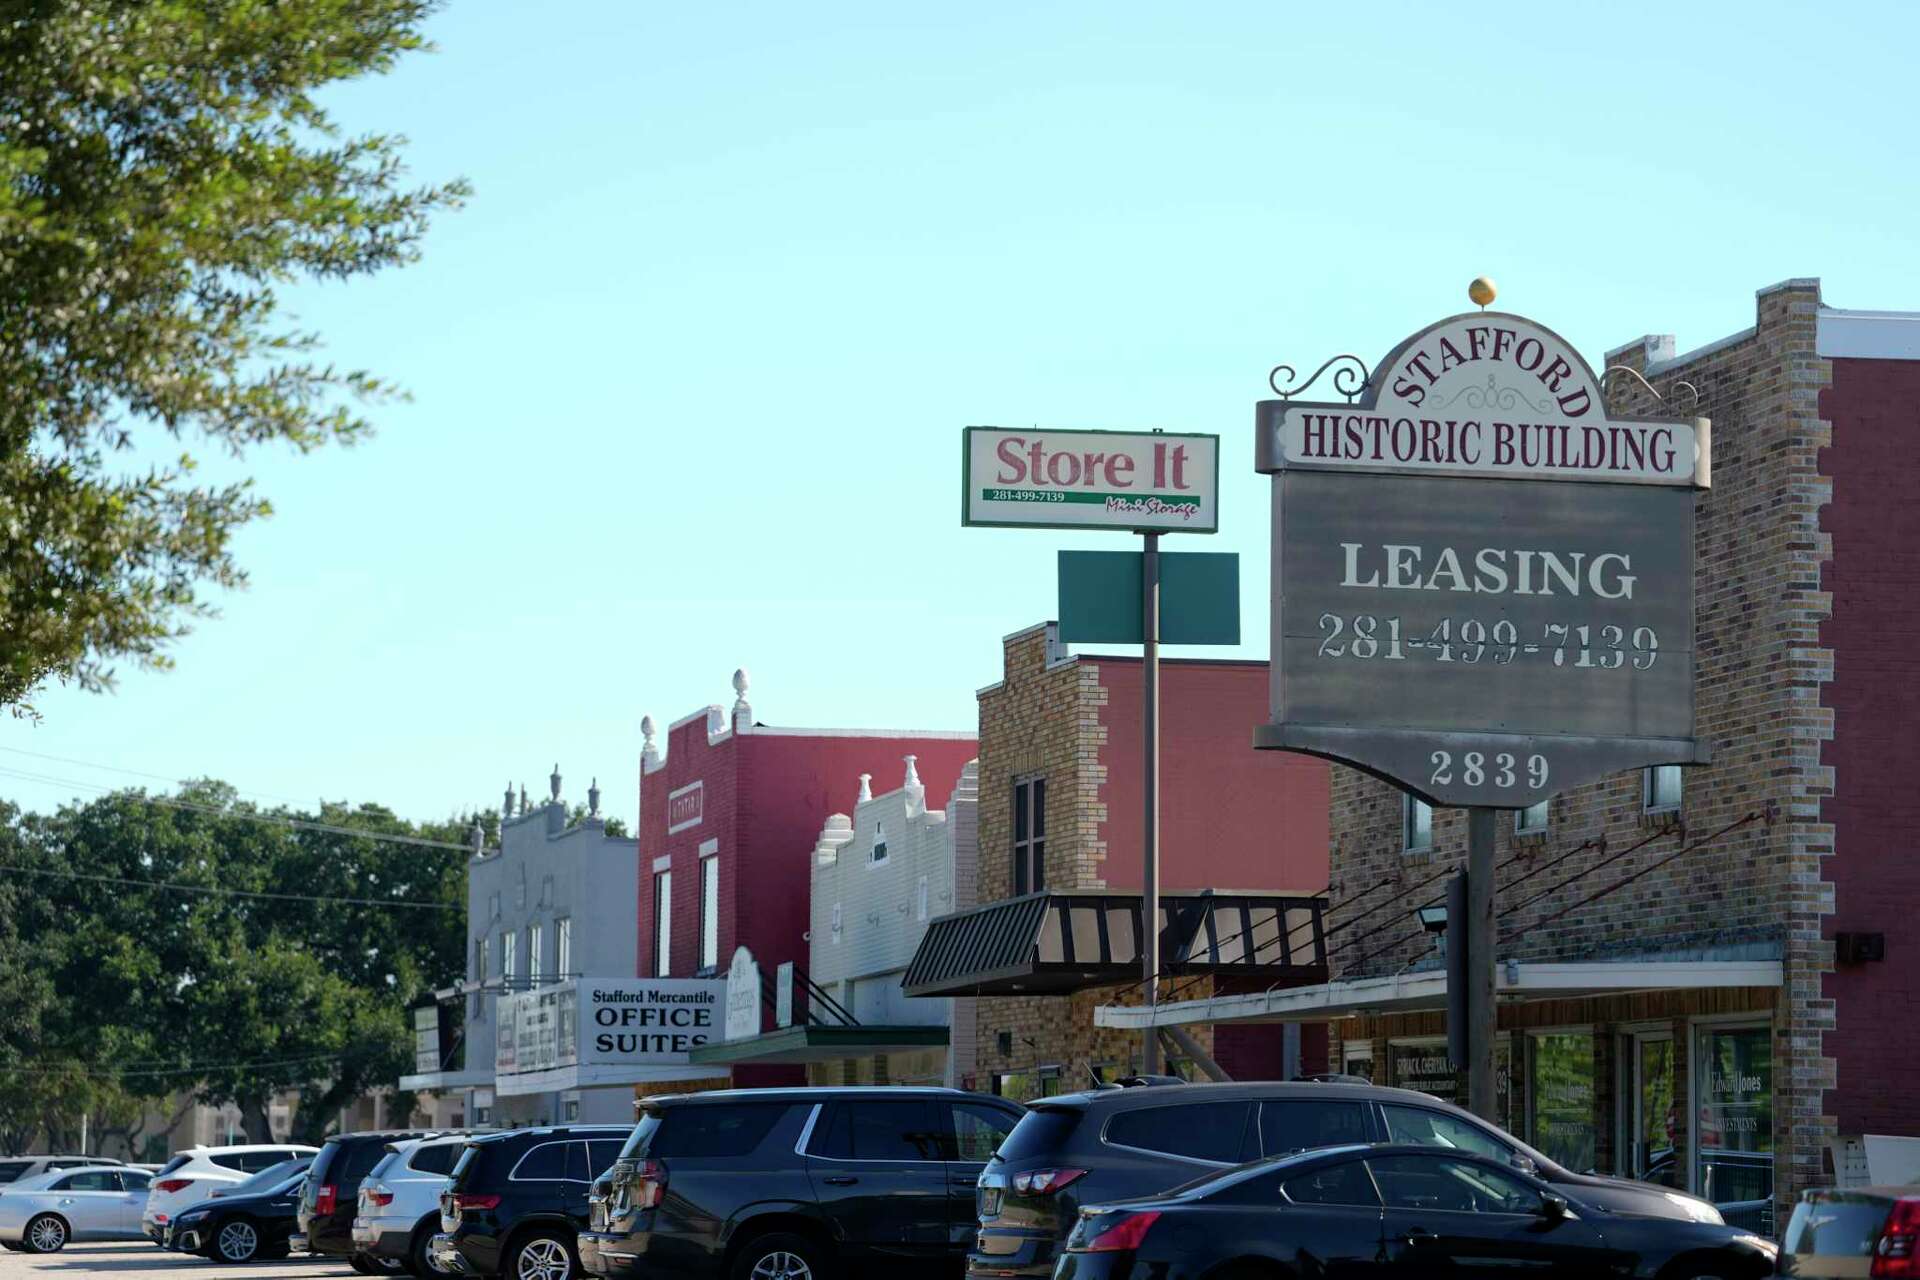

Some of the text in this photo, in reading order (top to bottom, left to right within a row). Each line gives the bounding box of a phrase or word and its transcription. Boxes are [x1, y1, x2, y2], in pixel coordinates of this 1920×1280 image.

[1393, 327, 1591, 419] STAFFORD
[996, 436, 1191, 490] Store It
[1300, 414, 1677, 473] HISTORIC BUILDING
[992, 490, 1065, 503] 281-499-7139
[1106, 496, 1198, 521] Mini Storage
[1340, 542, 1638, 600] LEASING
[1317, 612, 1659, 671] 281-499-7139
[1430, 750, 1550, 790] 2839
[592, 989, 644, 1004] Stafford
[648, 990, 715, 1005] Mercantile
[595, 1007, 712, 1027] OFFICE
